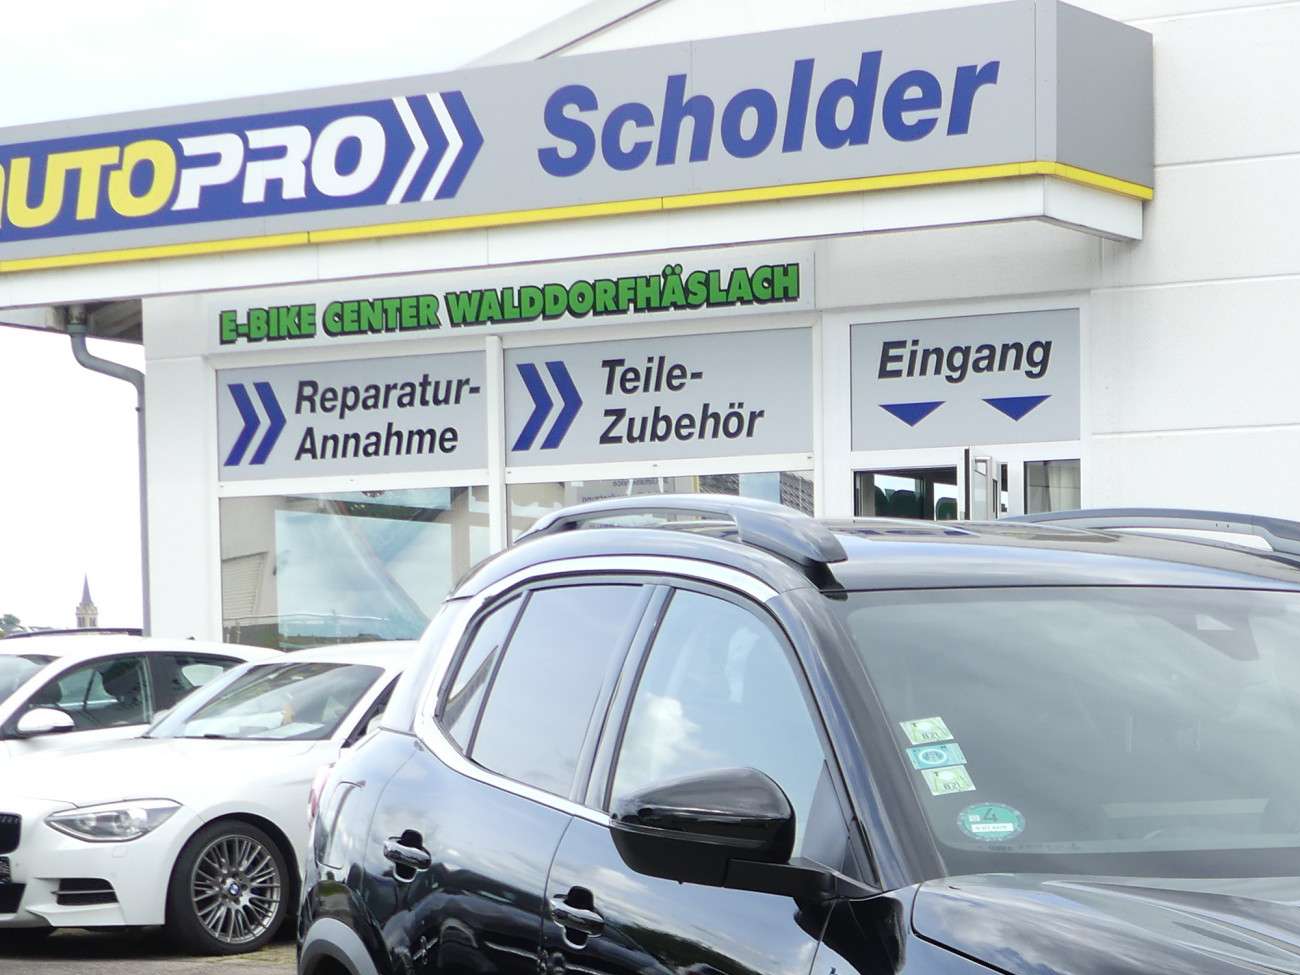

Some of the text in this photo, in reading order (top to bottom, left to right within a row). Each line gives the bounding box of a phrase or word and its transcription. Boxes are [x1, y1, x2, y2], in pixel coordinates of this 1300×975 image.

[538, 50, 1001, 178] Scholder
[220, 263, 801, 345] E-BIKE CENTER WALDDORFHÄSLACH
[603, 356, 704, 395] Teile-
[878, 339, 1053, 383] Eingang
[295, 374, 481, 419] Reparatur-
[294, 423, 459, 462] Annahme
[599, 403, 765, 446] Zubehör
